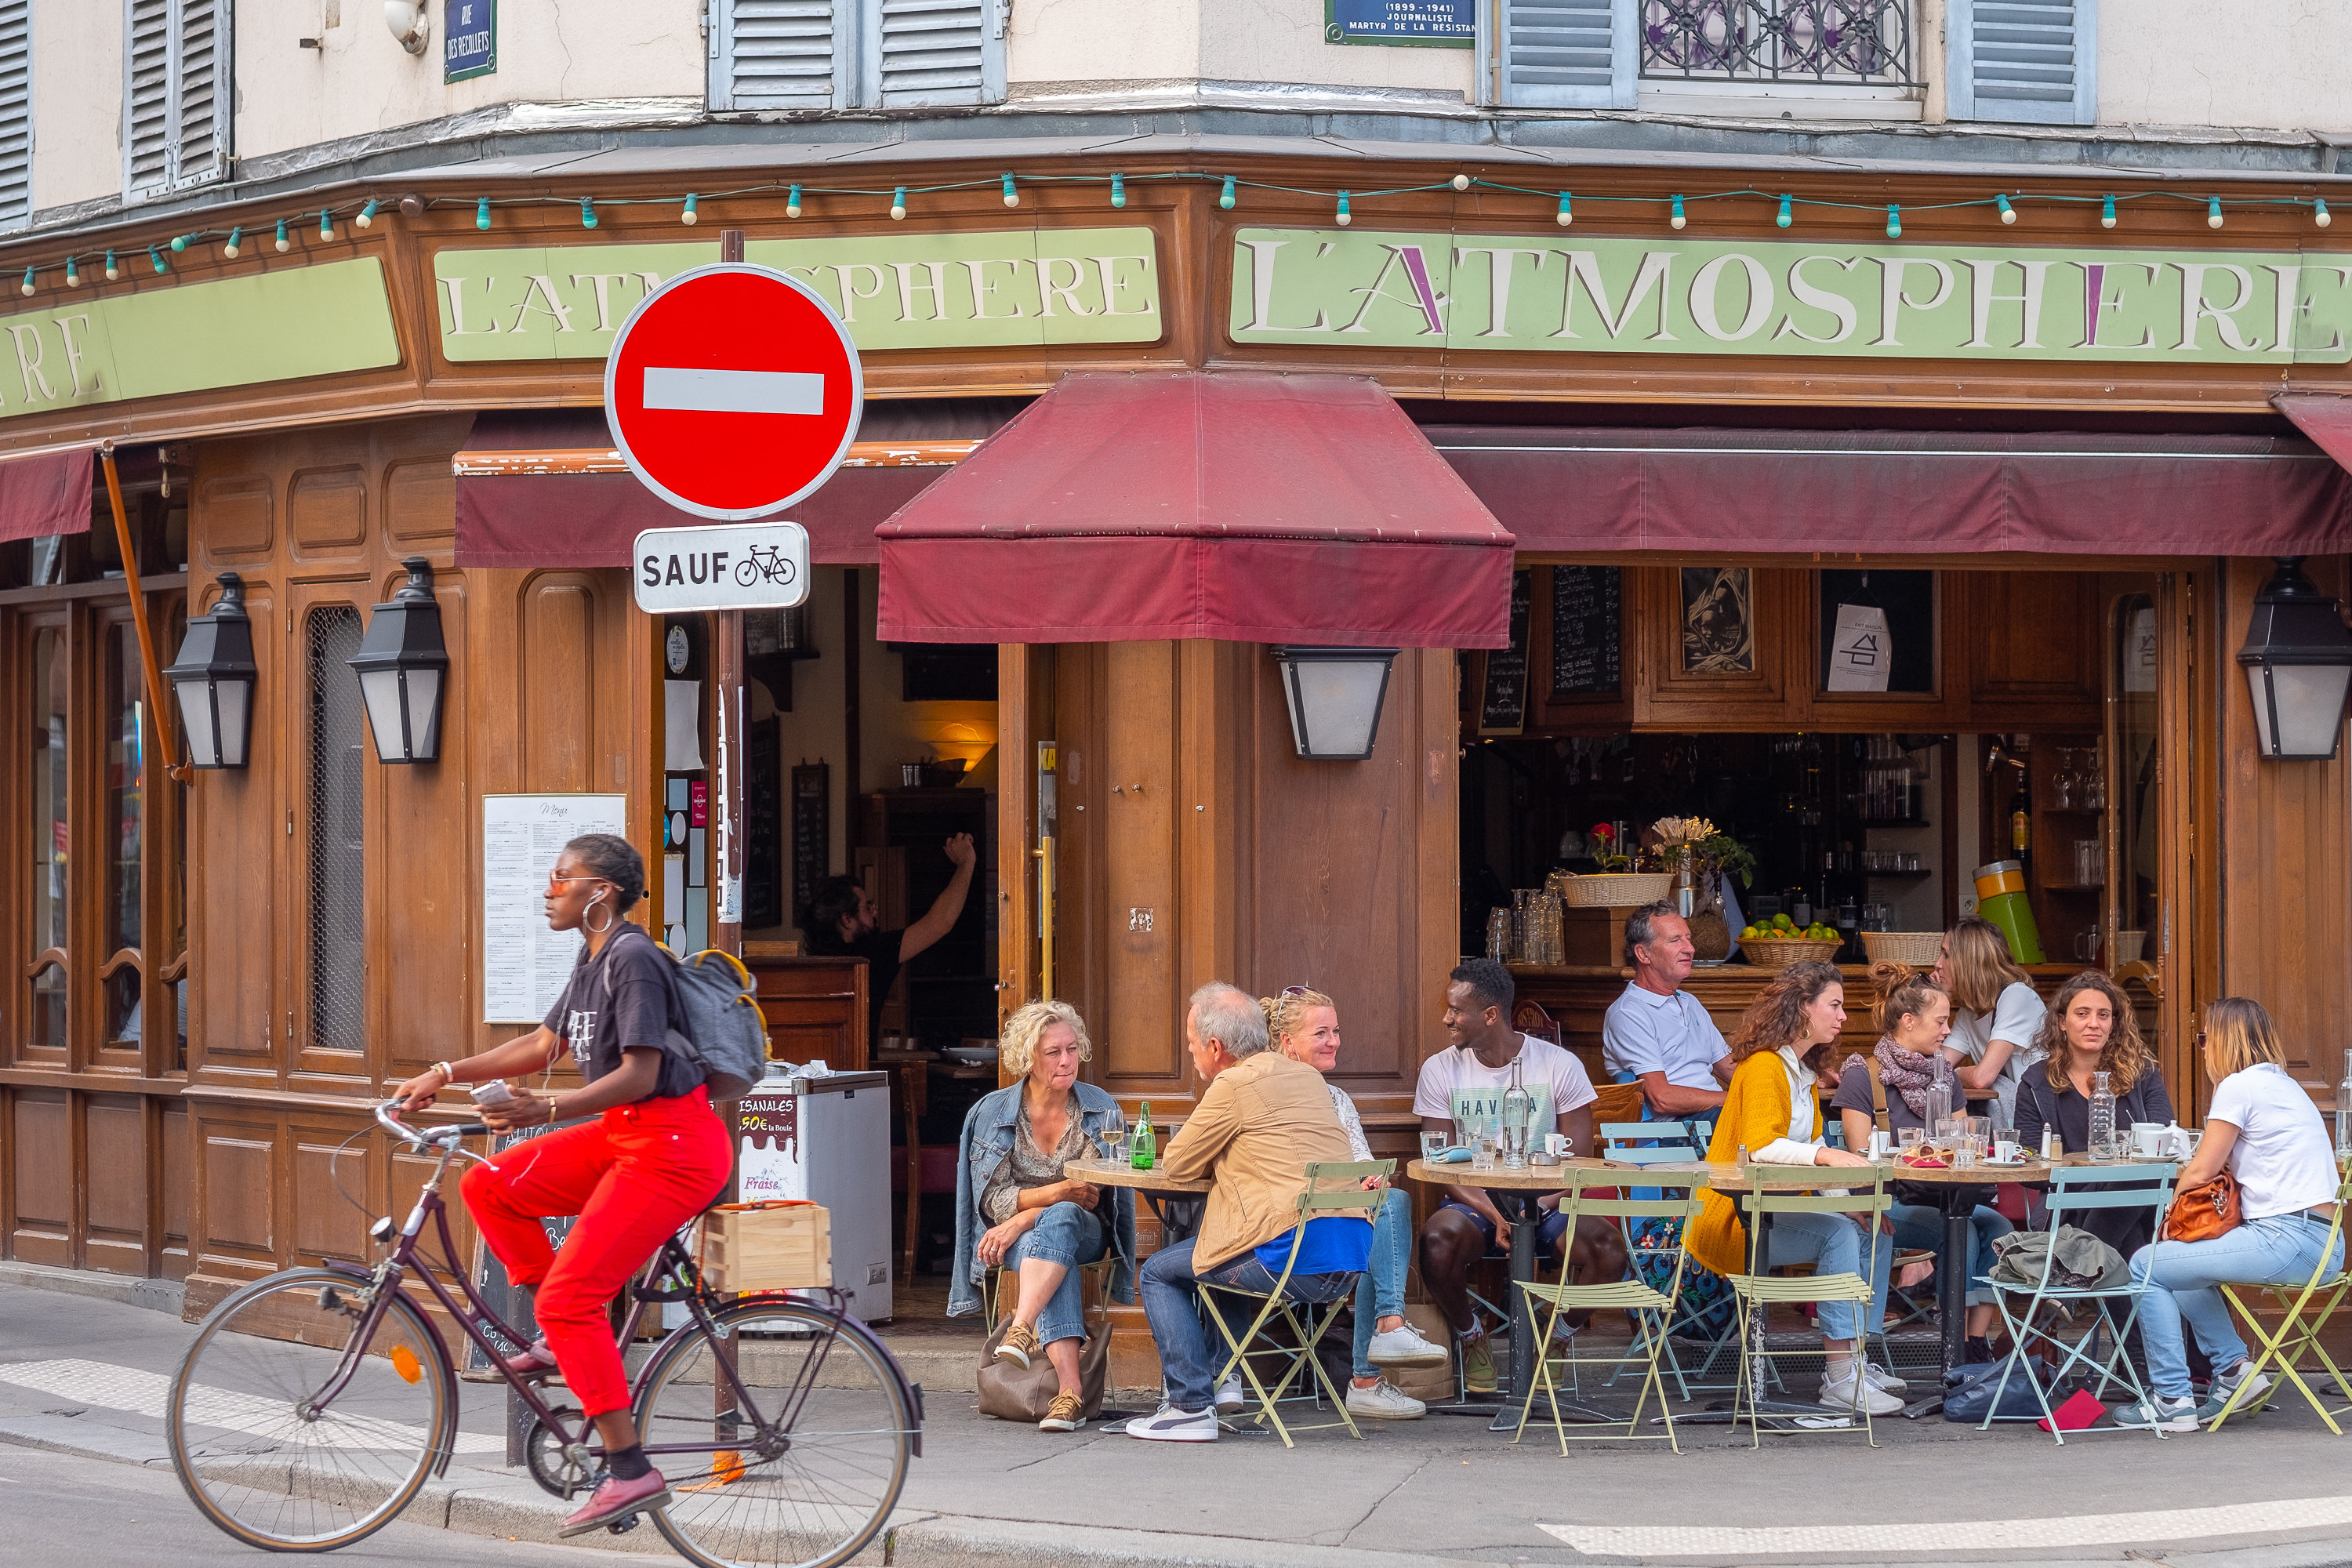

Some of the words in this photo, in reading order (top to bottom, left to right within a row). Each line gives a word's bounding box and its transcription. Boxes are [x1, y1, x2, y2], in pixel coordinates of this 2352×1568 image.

[461, 4, 472, 26] RUE
[1387, 13, 1454, 22] JOURNALISTE
[1432, 22, 1475, 32] RÉSISTAN
[448, 38, 458, 60] DES
[458, 31, 489, 56] RECOLLETS
[436, 256, 1155, 334] L'ATPHERE
[1236, 241, 2352, 352] L'ATMOSPHERE
[0, 314, 103, 406] RE
[643, 552, 728, 587] SAUF
[539, 802, 568, 817] Menu
[739, 1100, 793, 1112] ISANALES
[1461, 1097, 1537, 1116] HAVA
[739, 1116, 768, 1131] ,50€
[744, 1177, 779, 1189] Fraise
